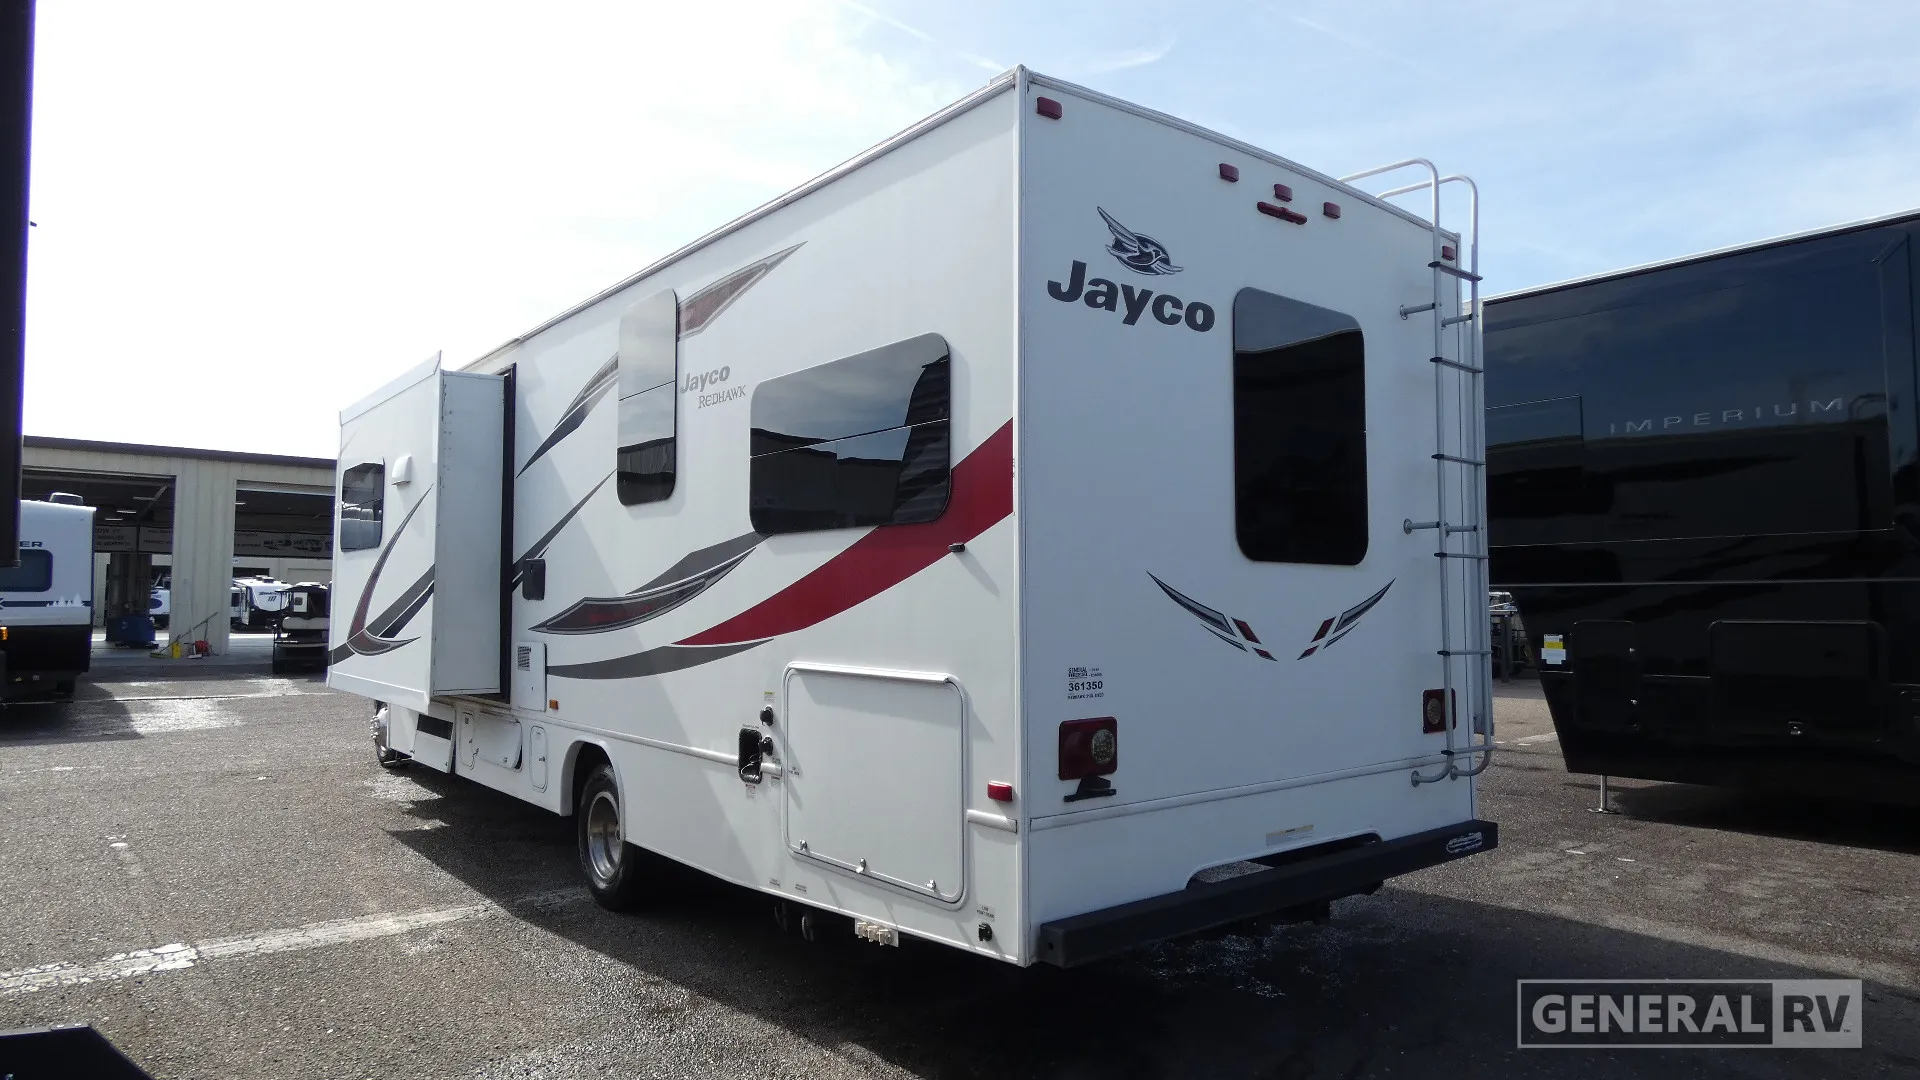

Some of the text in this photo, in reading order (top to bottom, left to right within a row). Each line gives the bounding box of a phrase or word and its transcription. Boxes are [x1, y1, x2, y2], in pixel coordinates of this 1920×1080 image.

[1047, 260, 1215, 332] Jayco
[680, 366, 730, 393] Jayco
[698, 385, 746, 409] REDHAWK
[1609, 396, 1845, 435] IMPERIUM
[1068, 681, 1103, 691] 361350
